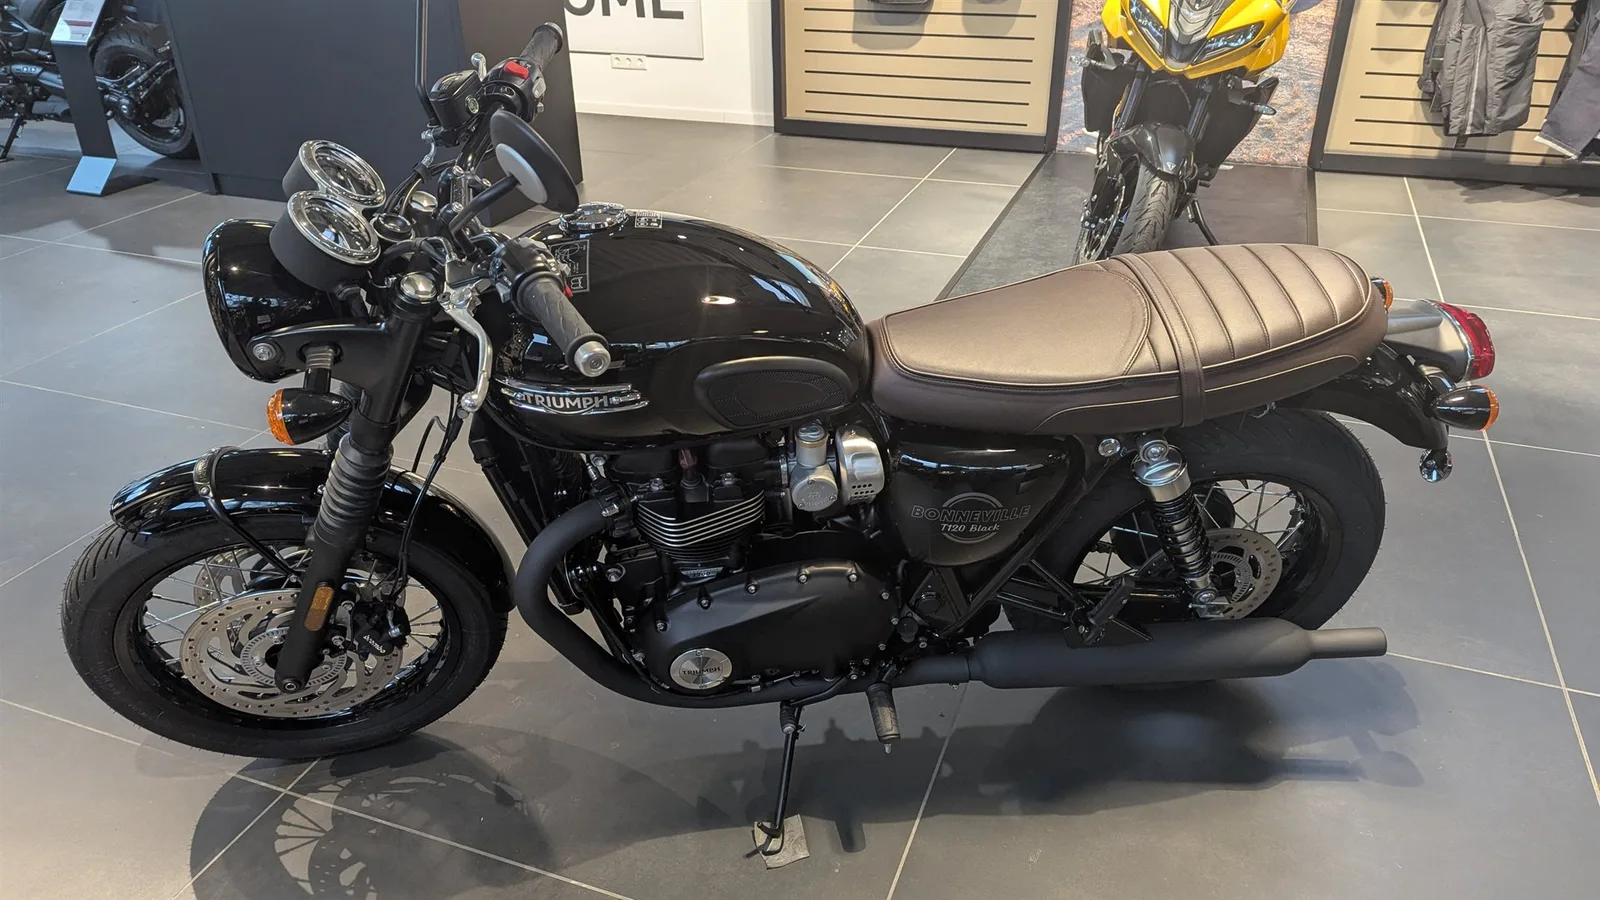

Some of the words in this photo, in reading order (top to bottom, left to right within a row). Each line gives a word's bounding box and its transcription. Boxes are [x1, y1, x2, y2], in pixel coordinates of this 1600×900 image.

[522, 392, 609, 411] TRIUMPH
[911, 505, 1030, 522] BONNEVILLE
[941, 523, 966, 533] T120
[969, 523, 1000, 533] Black
[682, 666, 721, 676] TRIUMPH
